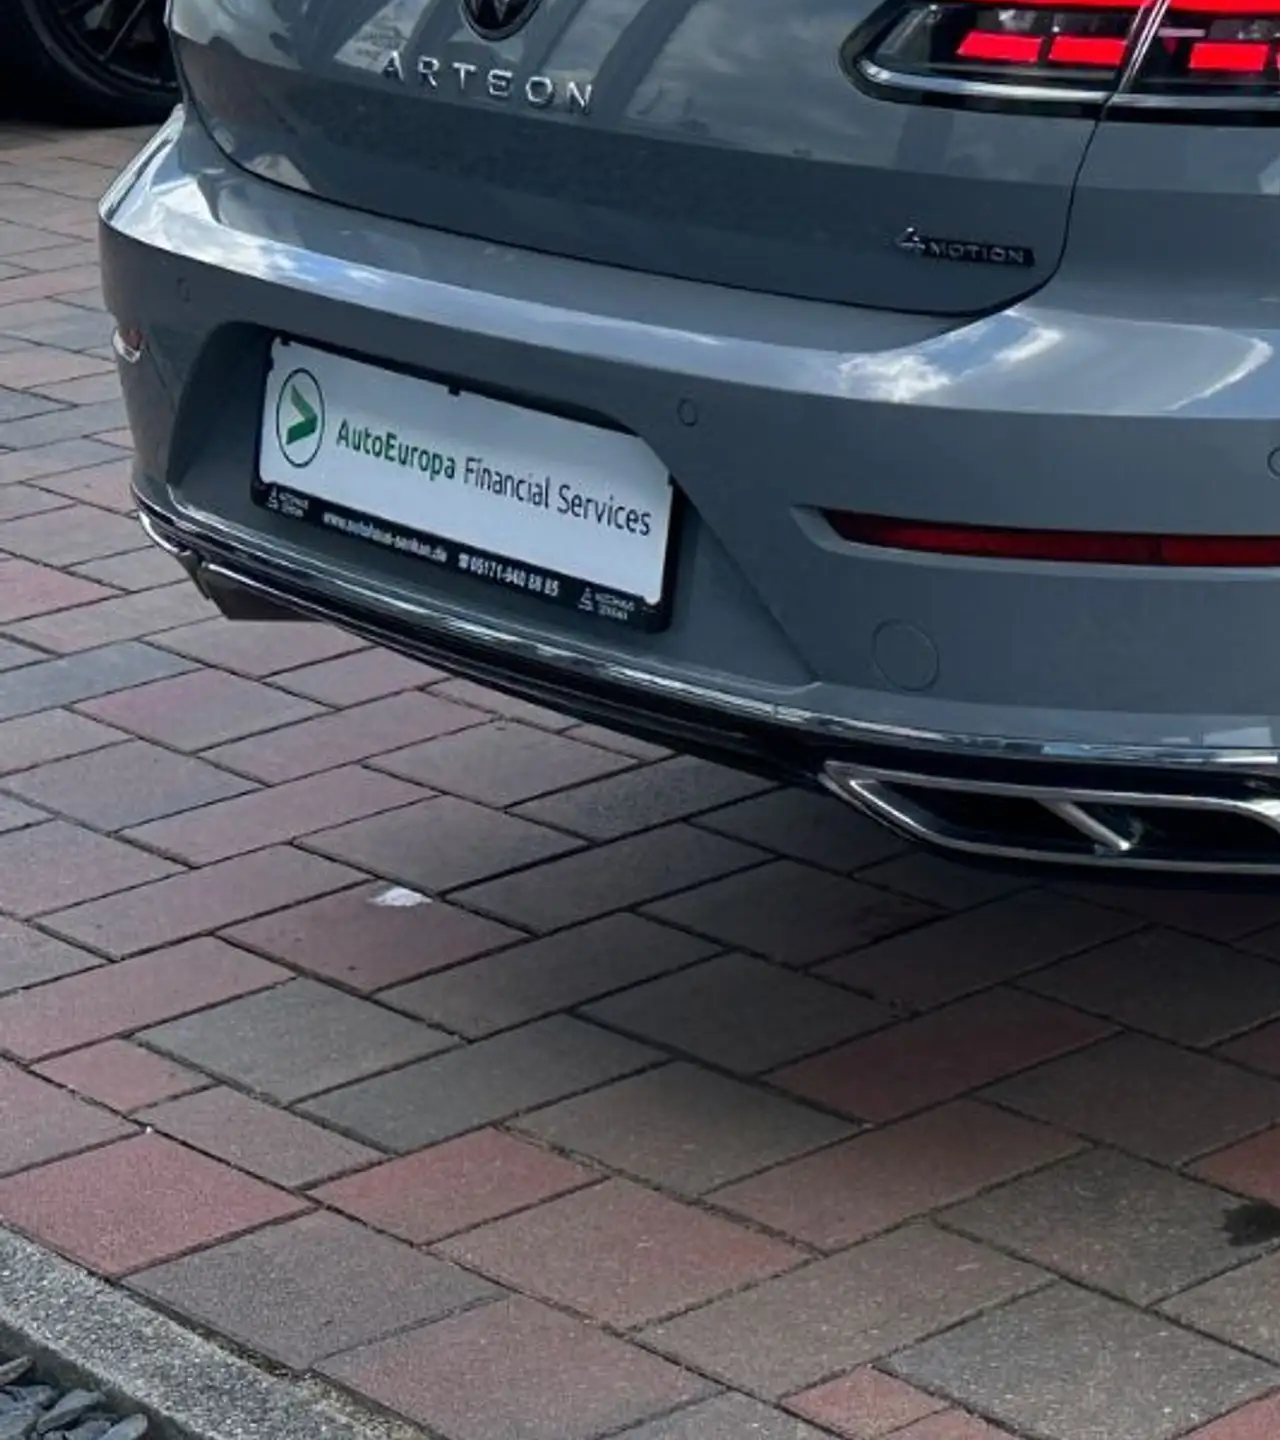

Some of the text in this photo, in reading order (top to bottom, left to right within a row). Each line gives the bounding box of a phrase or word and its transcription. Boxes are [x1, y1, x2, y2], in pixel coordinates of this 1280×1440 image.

[383, 50, 593, 114] ARTEON
[337, 419, 652, 538] AutoEuropa Financial Services
